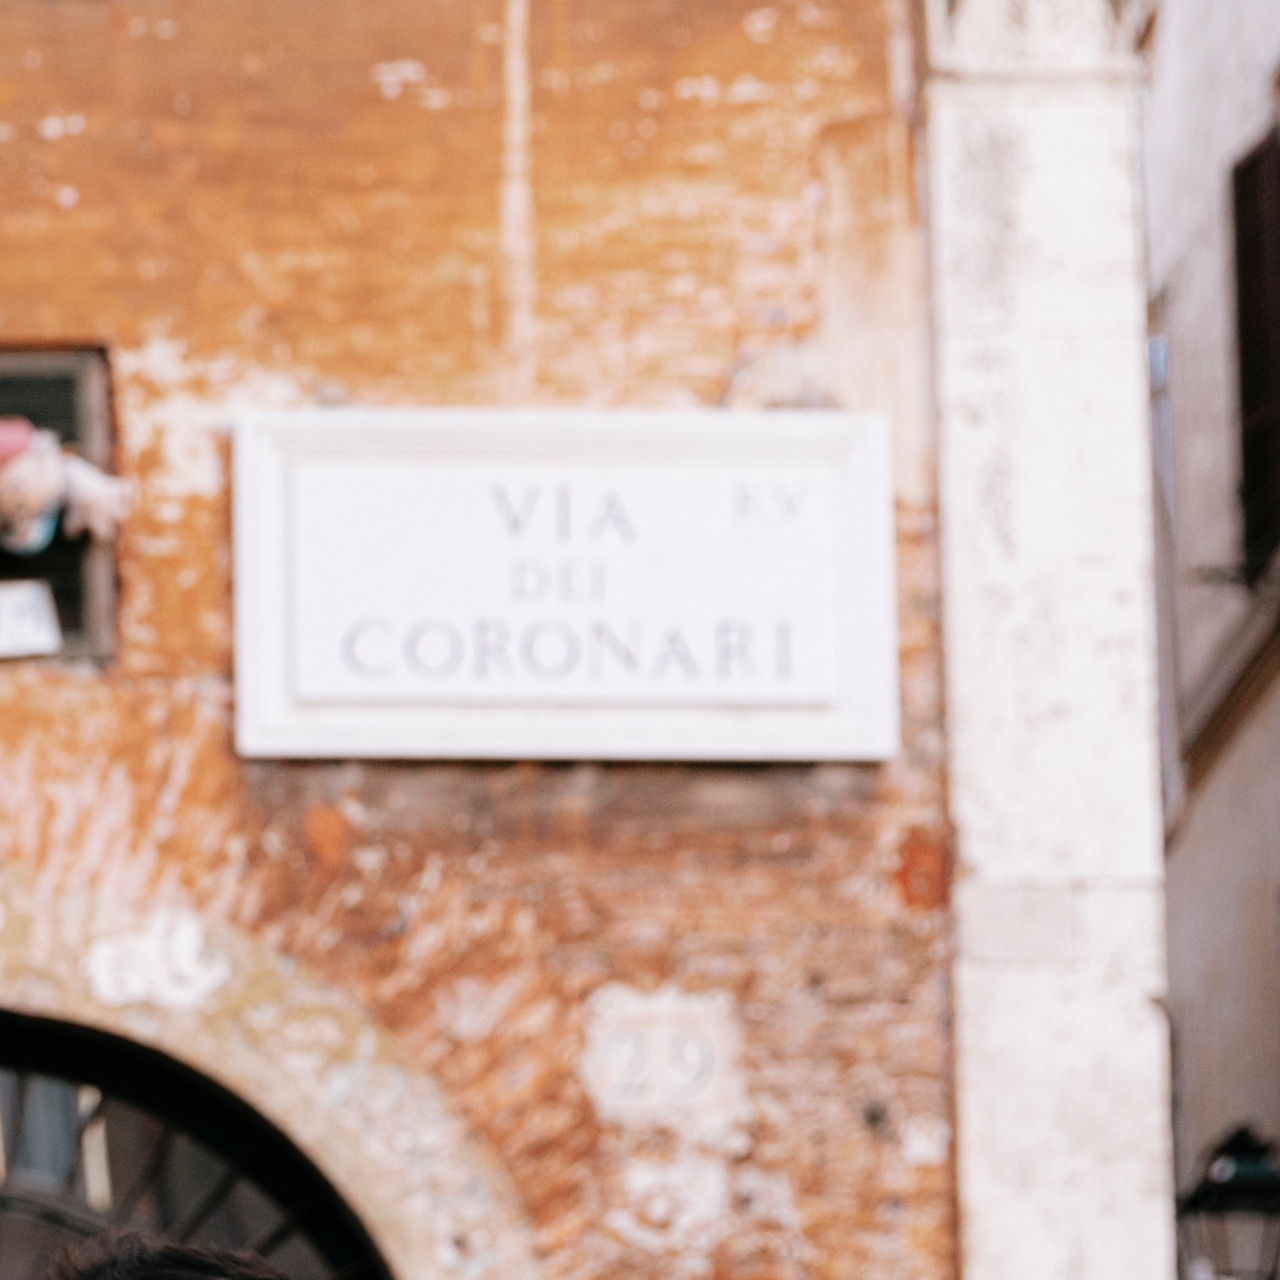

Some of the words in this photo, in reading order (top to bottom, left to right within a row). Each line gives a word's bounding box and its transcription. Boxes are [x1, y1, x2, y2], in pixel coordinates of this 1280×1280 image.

[488, 479, 639, 546] VIA
[339, 615, 795, 682] CORONARI
[608, 1024, 716, 1099] 29
